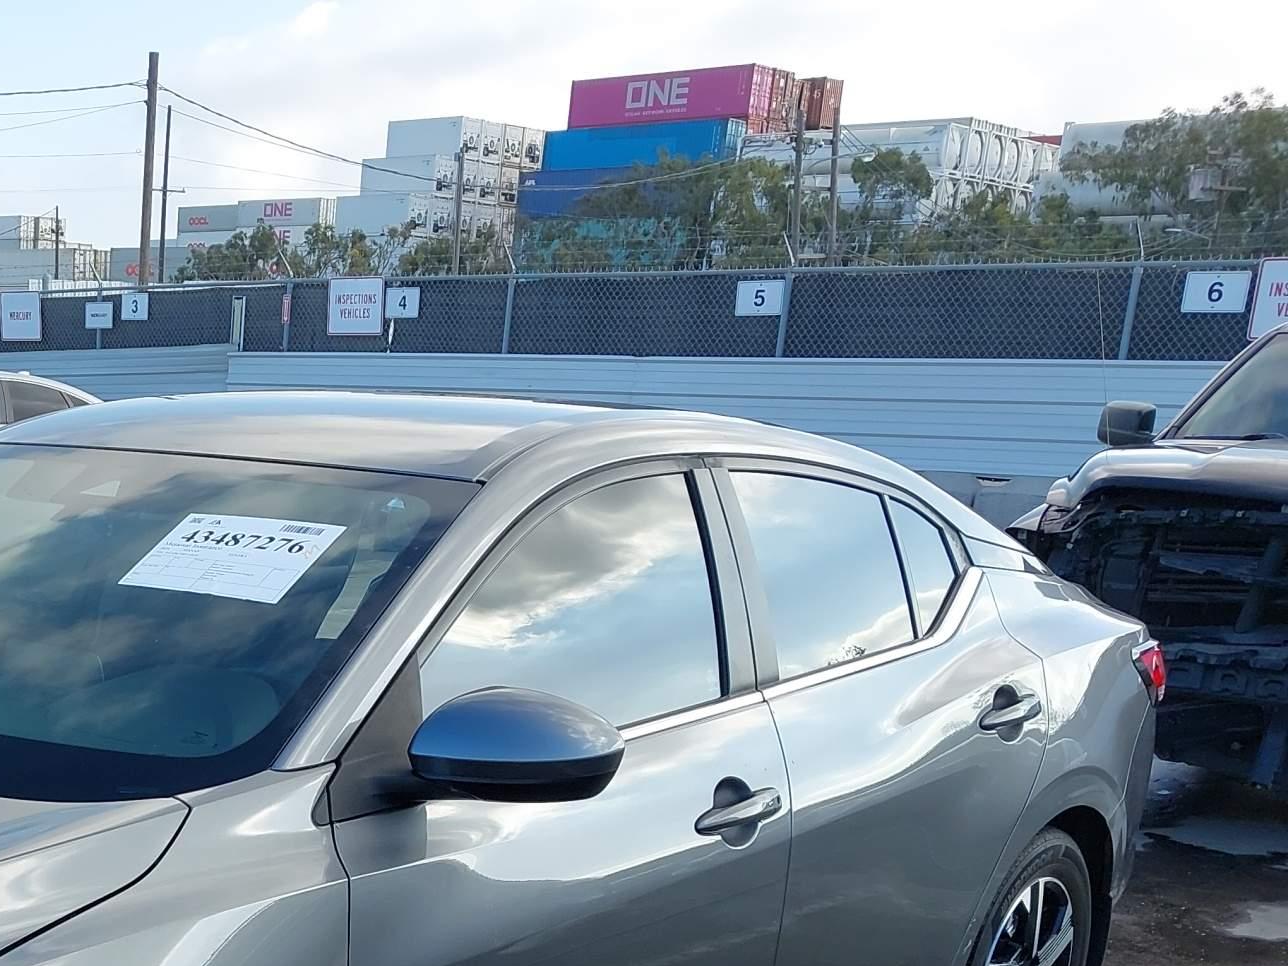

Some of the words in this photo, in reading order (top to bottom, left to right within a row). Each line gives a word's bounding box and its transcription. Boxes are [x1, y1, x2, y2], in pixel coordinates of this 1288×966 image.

[626, 77, 690, 109] ONE
[264, 202, 292, 217] ONE
[189, 216, 208, 226] OOCL
[334, 294, 377, 305] INSPECTIONS
[753, 289, 766, 307] 5
[1207, 281, 1224, 303] 6
[131, 300, 138, 314] 3
[398, 295, 407, 310] 4
[9, 312, 32, 321] MERCURY
[339, 308, 371, 319] VEHICLES
[181, 529, 312, 554] 43487276
